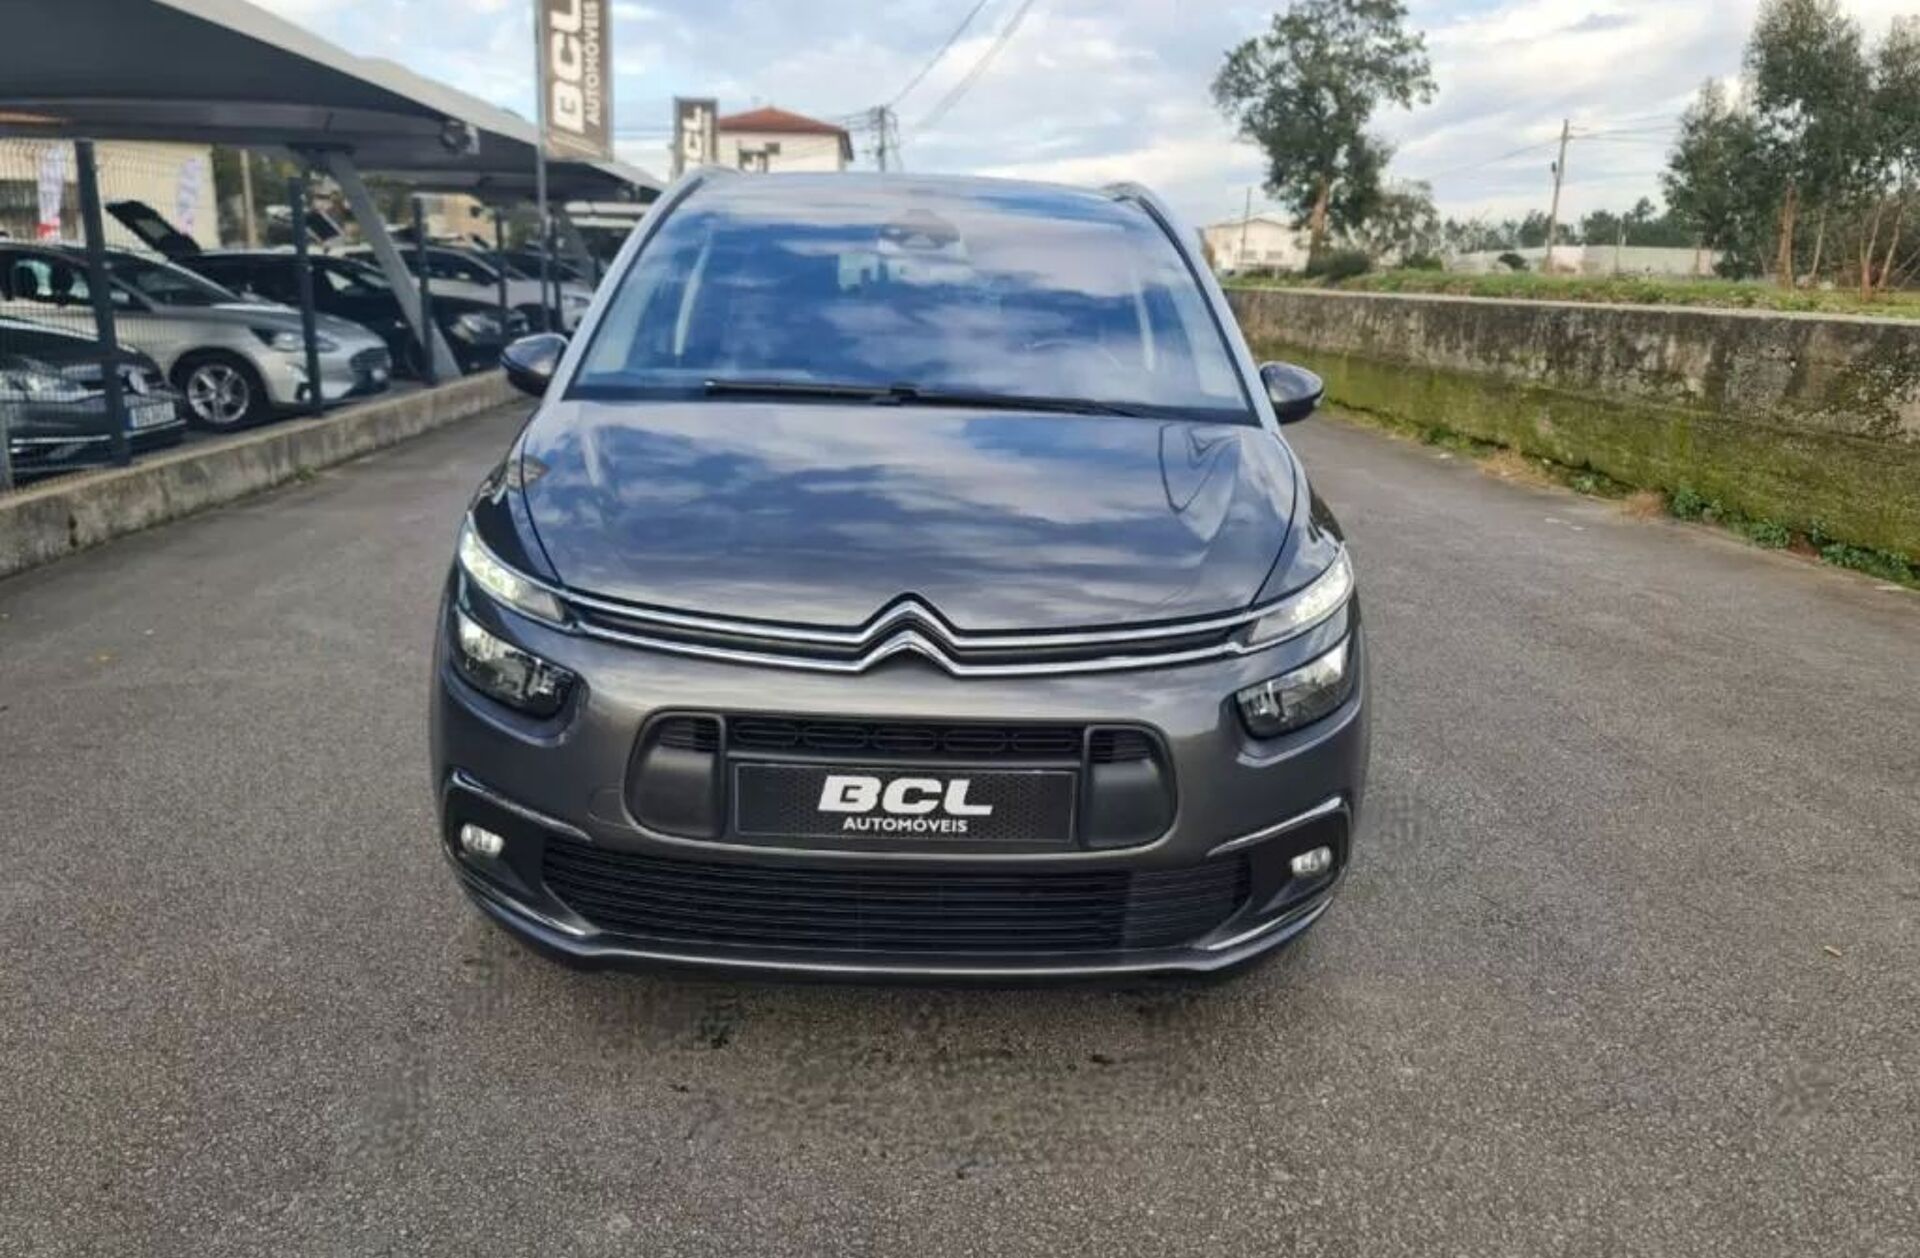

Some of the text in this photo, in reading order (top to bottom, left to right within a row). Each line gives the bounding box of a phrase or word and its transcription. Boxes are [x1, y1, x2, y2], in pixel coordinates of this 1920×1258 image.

[551, 0, 586, 134] BCL
[682, 107, 702, 168] CL
[818, 775, 993, 816] BCL
[842, 816, 968, 833] AUTOMÓVEIS
